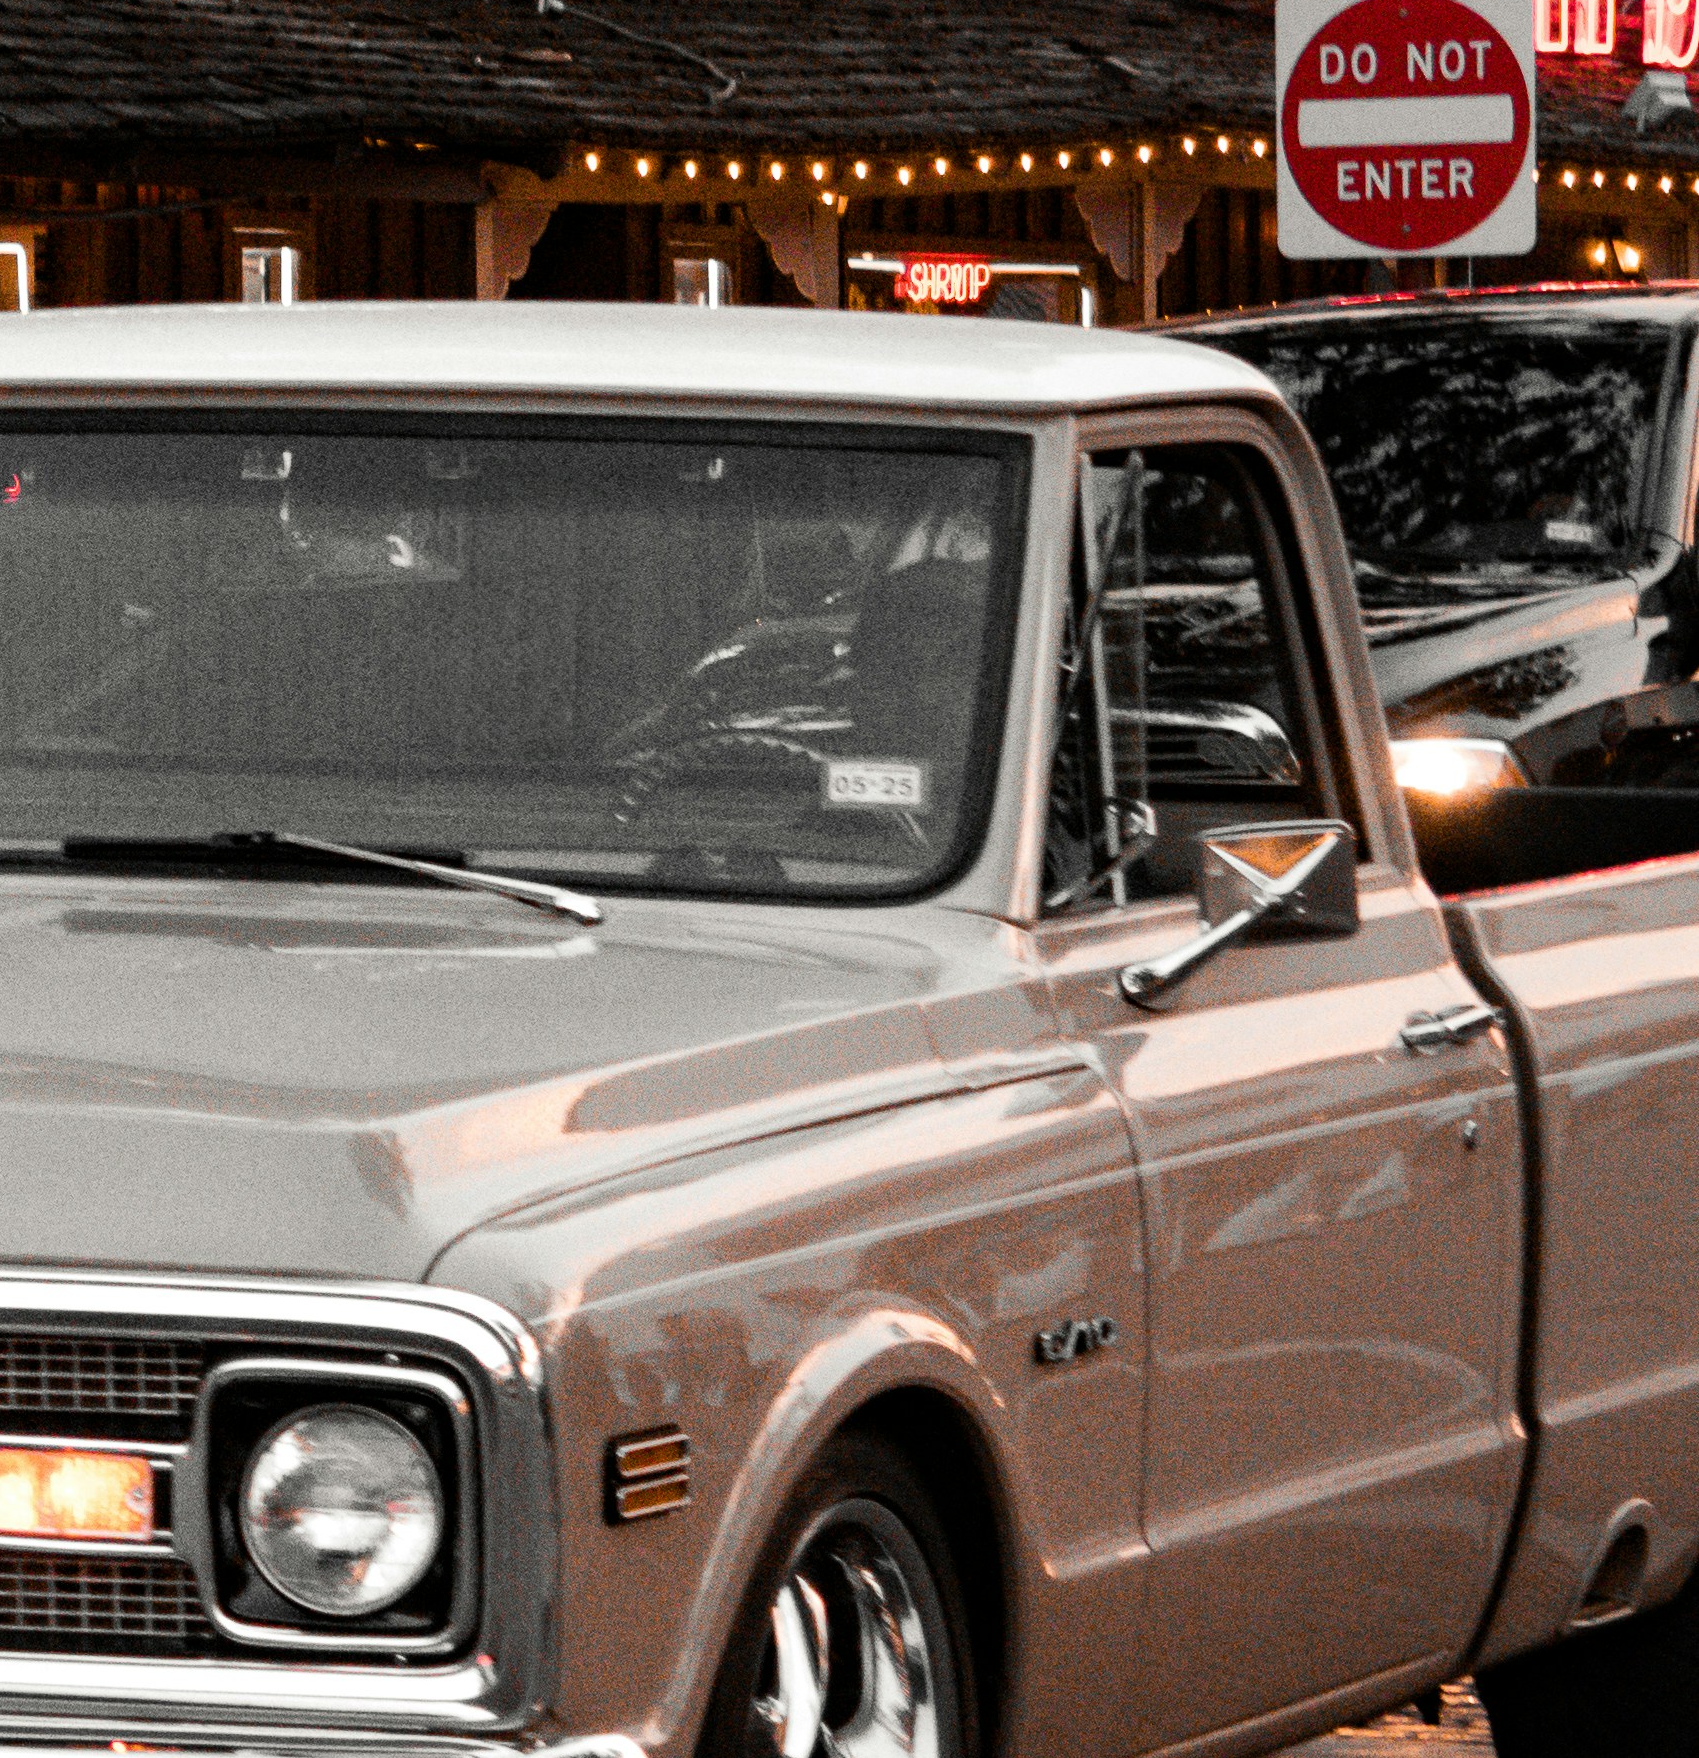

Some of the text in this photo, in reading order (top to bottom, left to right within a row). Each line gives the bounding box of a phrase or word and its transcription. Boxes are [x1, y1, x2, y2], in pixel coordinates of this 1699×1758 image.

[1319, 41, 1491, 85] DO NOT
[1336, 158, 1475, 203] ENTER
